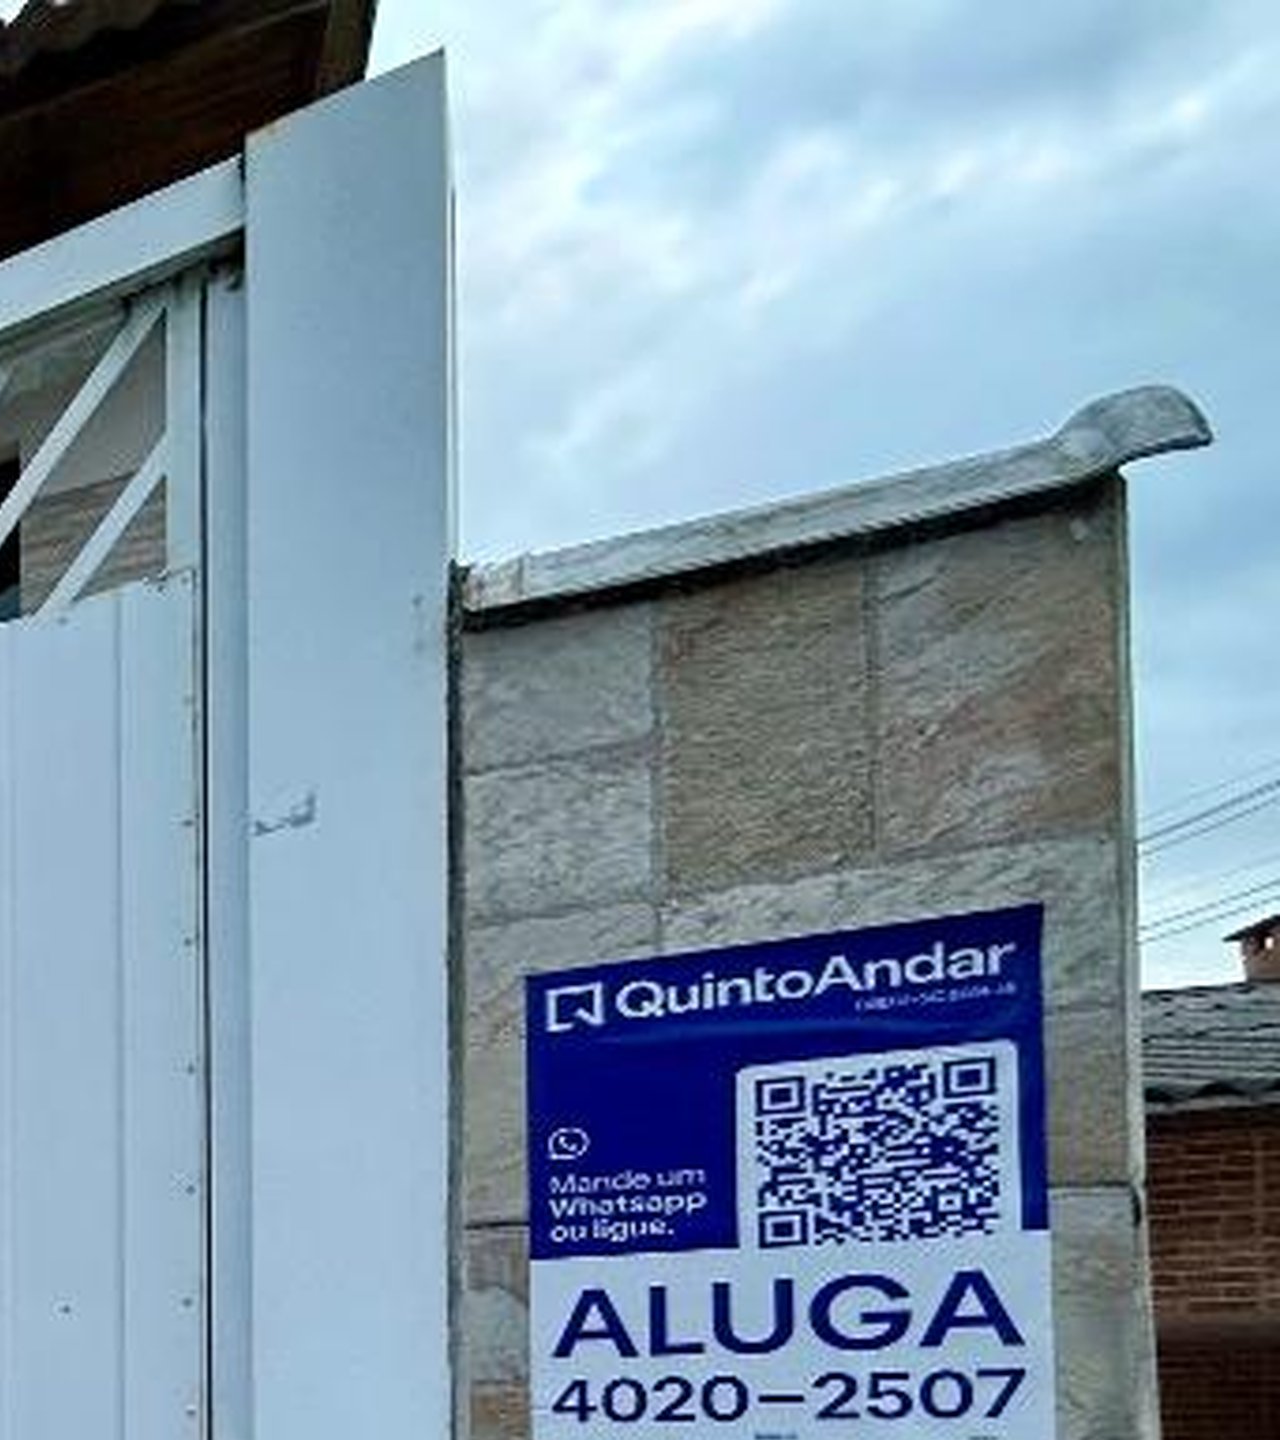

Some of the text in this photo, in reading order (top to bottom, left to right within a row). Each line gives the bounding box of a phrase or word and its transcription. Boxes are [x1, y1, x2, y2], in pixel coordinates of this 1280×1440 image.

[614, 941, 1018, 1019] QuintoAndar
[548, 1168, 707, 1194] Mande um
[548, 1191, 709, 1220] Whatsapp
[550, 1217, 676, 1243] ou ligue.
[551, 1269, 1025, 1359] ALUGA
[551, 1367, 1028, 1424] 4020-2507
